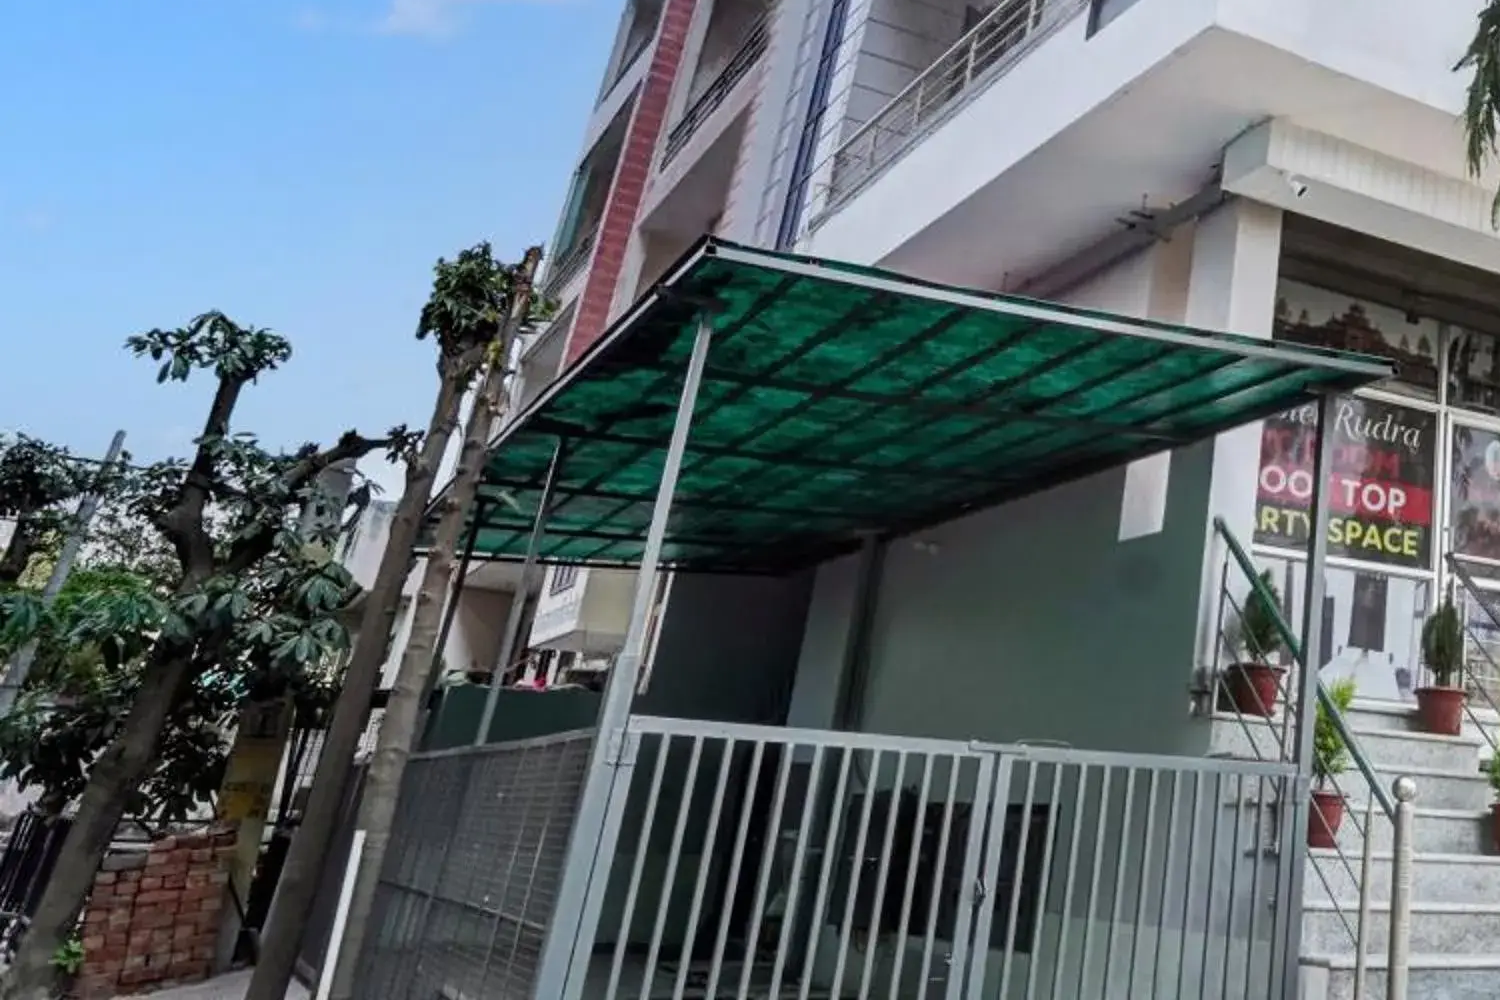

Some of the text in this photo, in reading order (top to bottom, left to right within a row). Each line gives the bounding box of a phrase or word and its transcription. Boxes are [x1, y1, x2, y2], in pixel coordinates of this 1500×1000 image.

[1334, 402, 1422, 449] Rudra
[1340, 478, 1407, 514] TOP
[1327, 516, 1419, 556] SPACE
